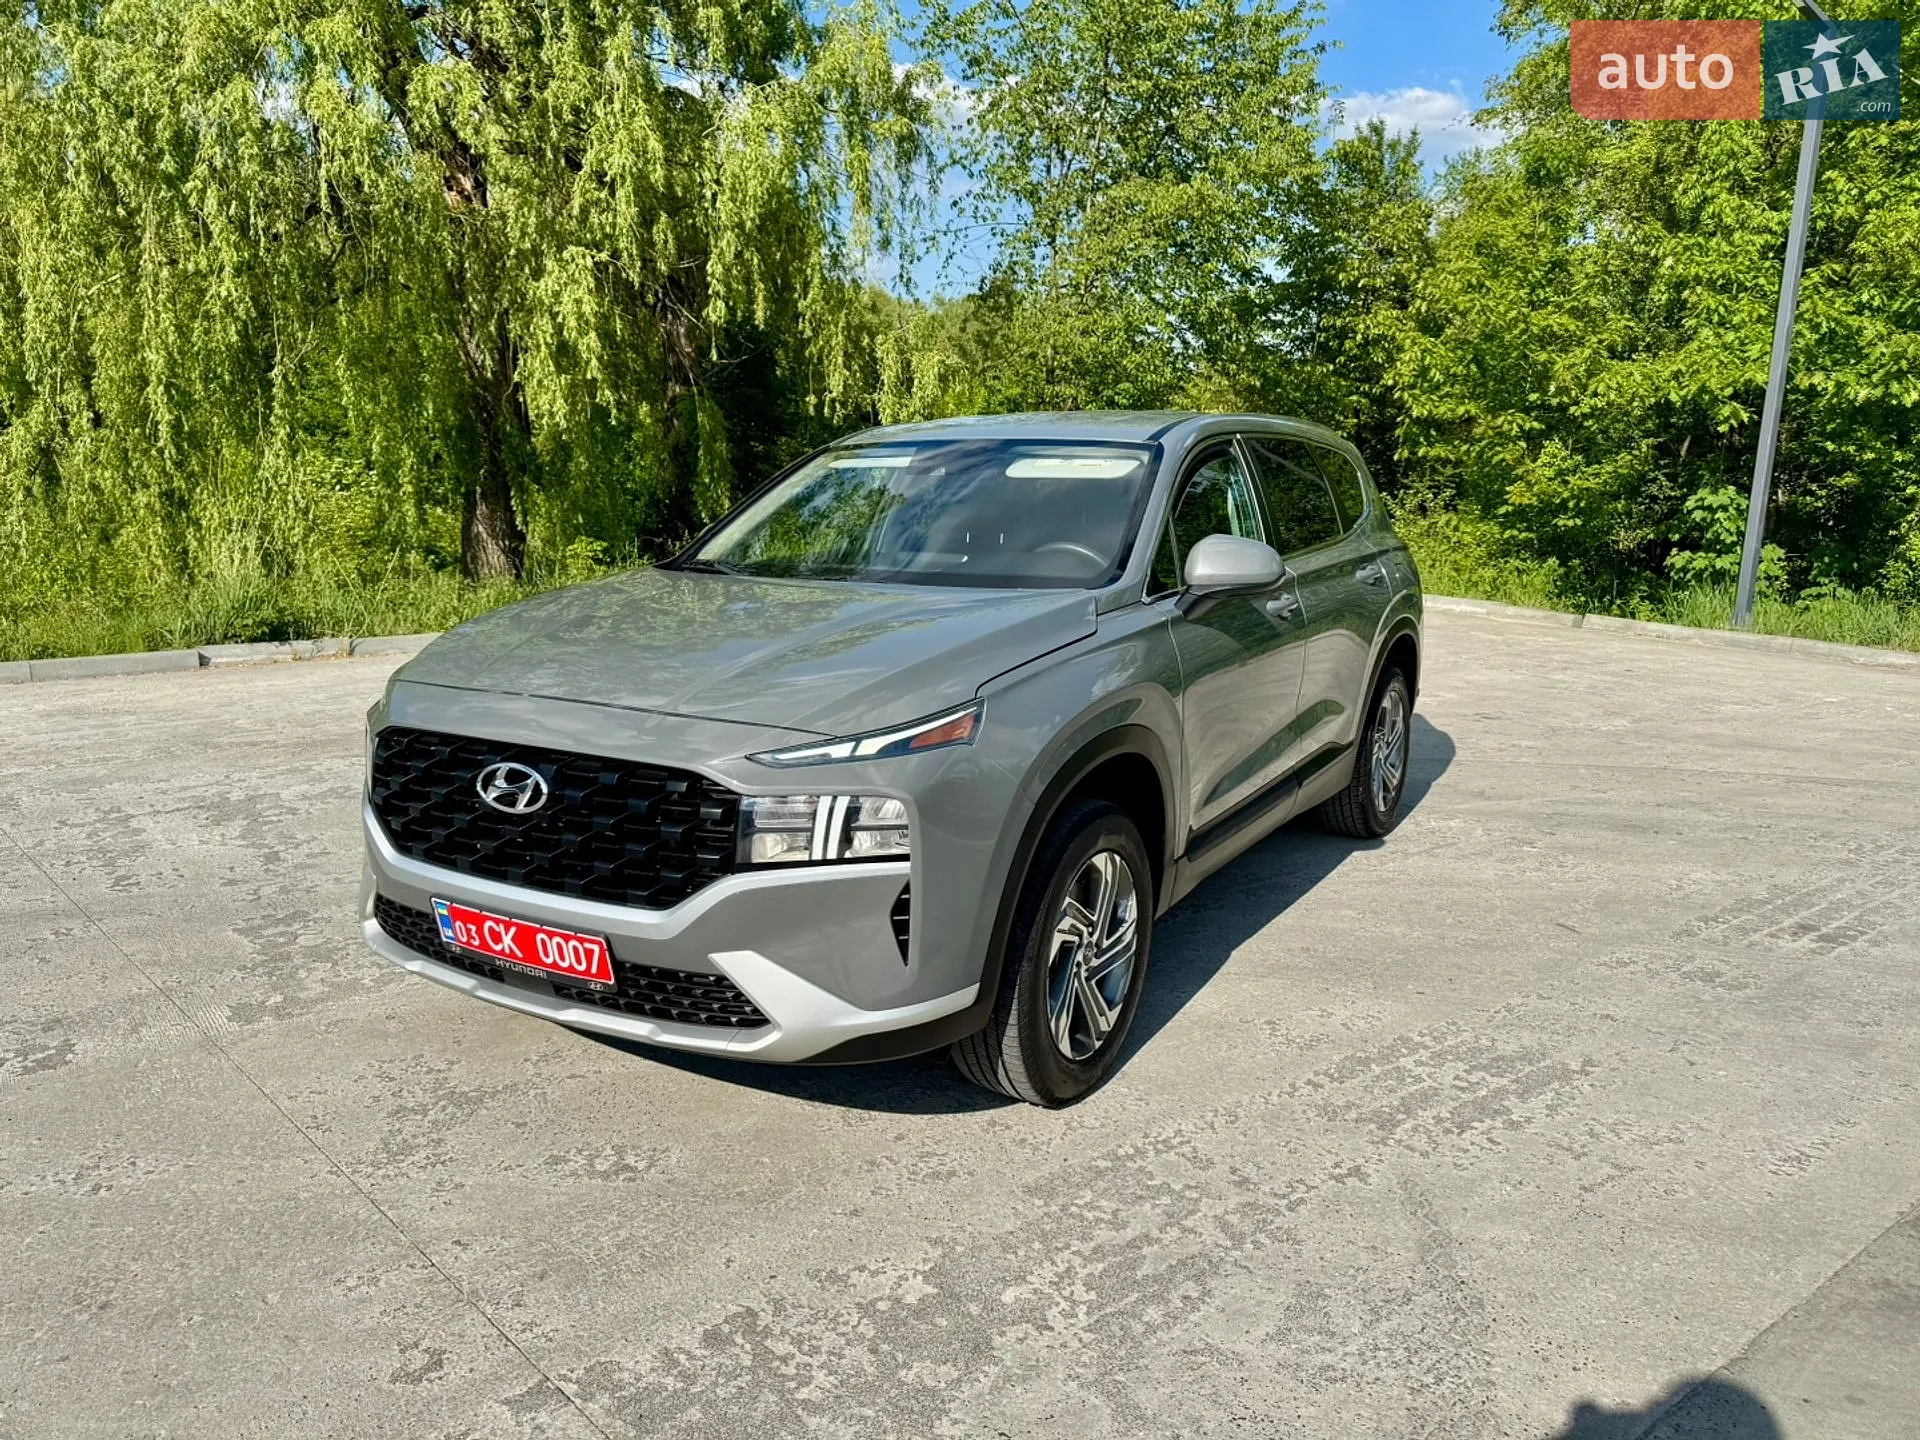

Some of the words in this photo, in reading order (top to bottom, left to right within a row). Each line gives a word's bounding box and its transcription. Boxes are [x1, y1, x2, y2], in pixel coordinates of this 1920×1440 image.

[455, 921, 480, 946] 03
[483, 920, 523, 958] CK
[535, 933, 600, 974] 0007
[495, 958, 547, 979] HYUNDAI
